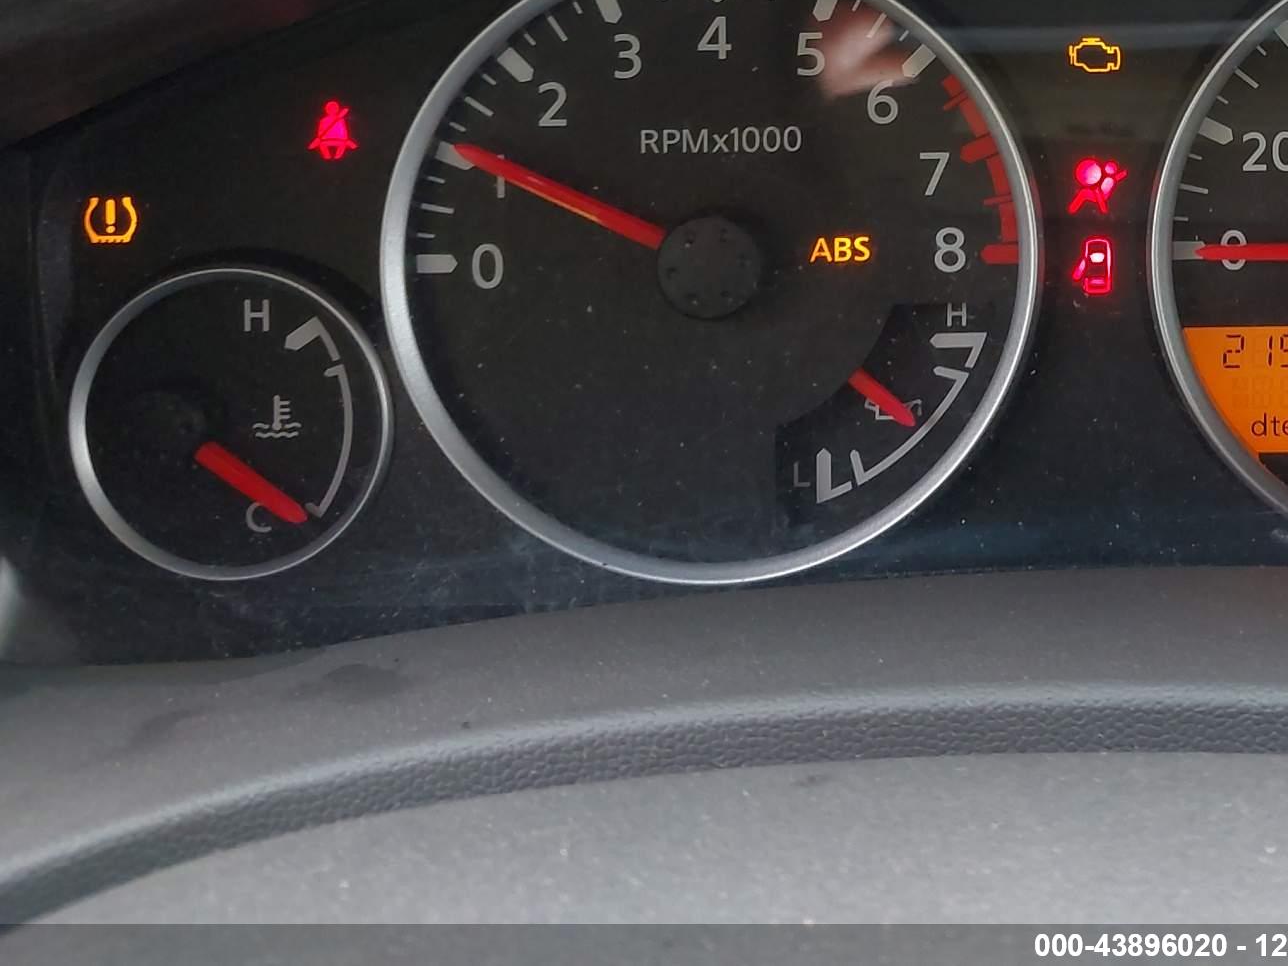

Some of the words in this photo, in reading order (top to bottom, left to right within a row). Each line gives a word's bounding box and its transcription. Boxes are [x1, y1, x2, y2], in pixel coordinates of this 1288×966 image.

[613, 34, 642, 79] 3
[697, 16, 732, 59] 4
[797, 32, 825, 76] 5
[538, 82, 567, 127] 2
[867, 80, 899, 125] 6
[640, 126, 802, 154] RPMx1000
[920, 152, 950, 196] 7
[472, 244, 504, 289] 0
[810, 236, 871, 263] ABS
[934, 227, 966, 273] 8
[243, 298, 270, 332] H
[946, 302, 967, 326] H
[793, 461, 811, 487] L
[245, 502, 272, 534] C
